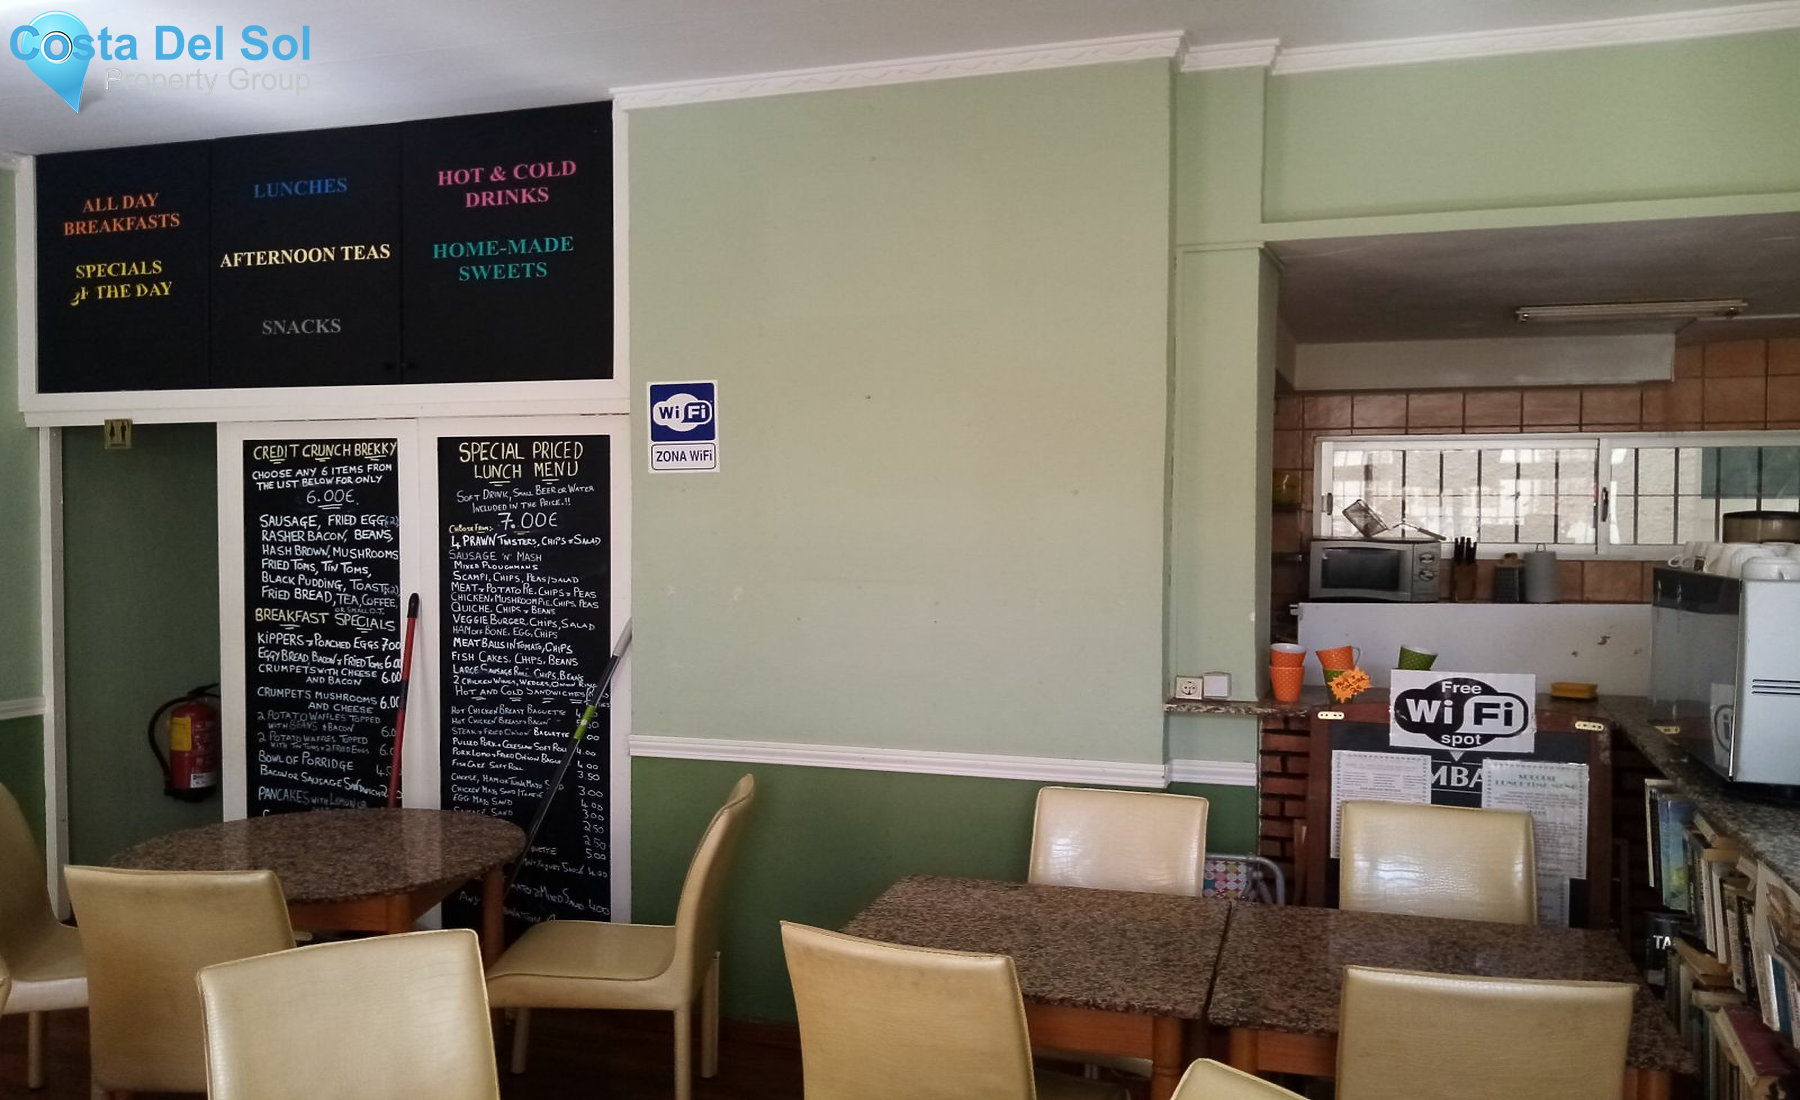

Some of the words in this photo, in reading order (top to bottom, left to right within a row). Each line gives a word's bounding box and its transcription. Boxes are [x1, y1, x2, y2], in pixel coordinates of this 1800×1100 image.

[438, 168, 484, 187] HOT
[490, 165, 507, 183] &
[511, 160, 577, 181] COLD
[253, 177, 348, 199] LUNCHES
[82, 197, 120, 213] ALL
[123, 192, 159, 211] DAY
[465, 187, 550, 209] DRINKS
[62, 211, 181, 237] BREAKFASTS
[219, 246, 337, 269] AFTERNOON
[340, 243, 391, 263] TEAS
[432, 237, 575, 259] HOME-MADE
[76, 260, 162, 279] SPECIALS
[458, 261, 548, 282] SWEETS
[97, 284, 131, 299] THE
[136, 281, 172, 297] DAY
[261, 317, 341, 335] SNACKS
[254, 444, 299, 460] CREDIT
[302, 444, 350, 457] CRUNCH
[354, 442, 397, 456] BREKKY
[459, 442, 525, 462] SPECIAL
[533, 441, 583, 460] PRICED
[656, 451, 687, 462] ZONA
[690, 450, 712, 461] WiFi
[252, 470, 292, 480] CHOOSE
[296, 468, 316, 477] ANY
[321, 467, 328, 475] 6
[332, 466, 363, 474] ITEMS
[474, 464, 521, 479] LUNCH
[534, 461, 578, 477] MENU
[257, 482, 274, 491] THE
[277, 480, 299, 488] LIST
[302, 477, 333, 486] BELOW
[355, 475, 382, 483] ONLY
[472, 503, 507, 513] INCLUDED
[260, 514, 321, 530] SAUSAGE,
[328, 515, 356, 526] FRIED
[262, 531, 306, 542] RASHER
[307, 530, 348, 542] BACON,
[354, 530, 393, 542] BEANS,
[451, 535, 461, 549] 4
[462, 533, 498, 547] PRAWN
[262, 545, 292, 555] HASH
[333, 548, 399, 560] MUSHROOMS
[449, 550, 497, 560] SAUSAGE
[517, 551, 542, 562] MASH
[262, 558, 289, 570] FRIED
[262, 572, 295, 585] BLACK
[574, 587, 597, 598] PEAS
[255, 608, 330, 624] BREAKFAST
[334, 613, 395, 632] SPECIALS
[452, 614, 487, 624] VEGGIE
[561, 618, 595, 630] SALAD
[314, 633, 351, 649] POACHED
[354, 637, 379, 649] EGGS
[452, 652, 474, 661] FISH
[548, 653, 578, 666] BEANS
[258, 664, 316, 674] CRUMPETS
[328, 676, 362, 686] BACON
[1441, 680, 1482, 694] Free
[257, 687, 311, 699] CRUMPETS
[315, 692, 377, 705] MUSHROOMS
[455, 685, 477, 696] HOT
[501, 685, 523, 696] COLD
[308, 702, 329, 710] AND
[333, 704, 374, 714] CHEESE
[1440, 732, 1482, 746] spot
[259, 750, 284, 762] BOWL
[286, 755, 298, 764] OF
[302, 752, 354, 772] PORRIDGE
